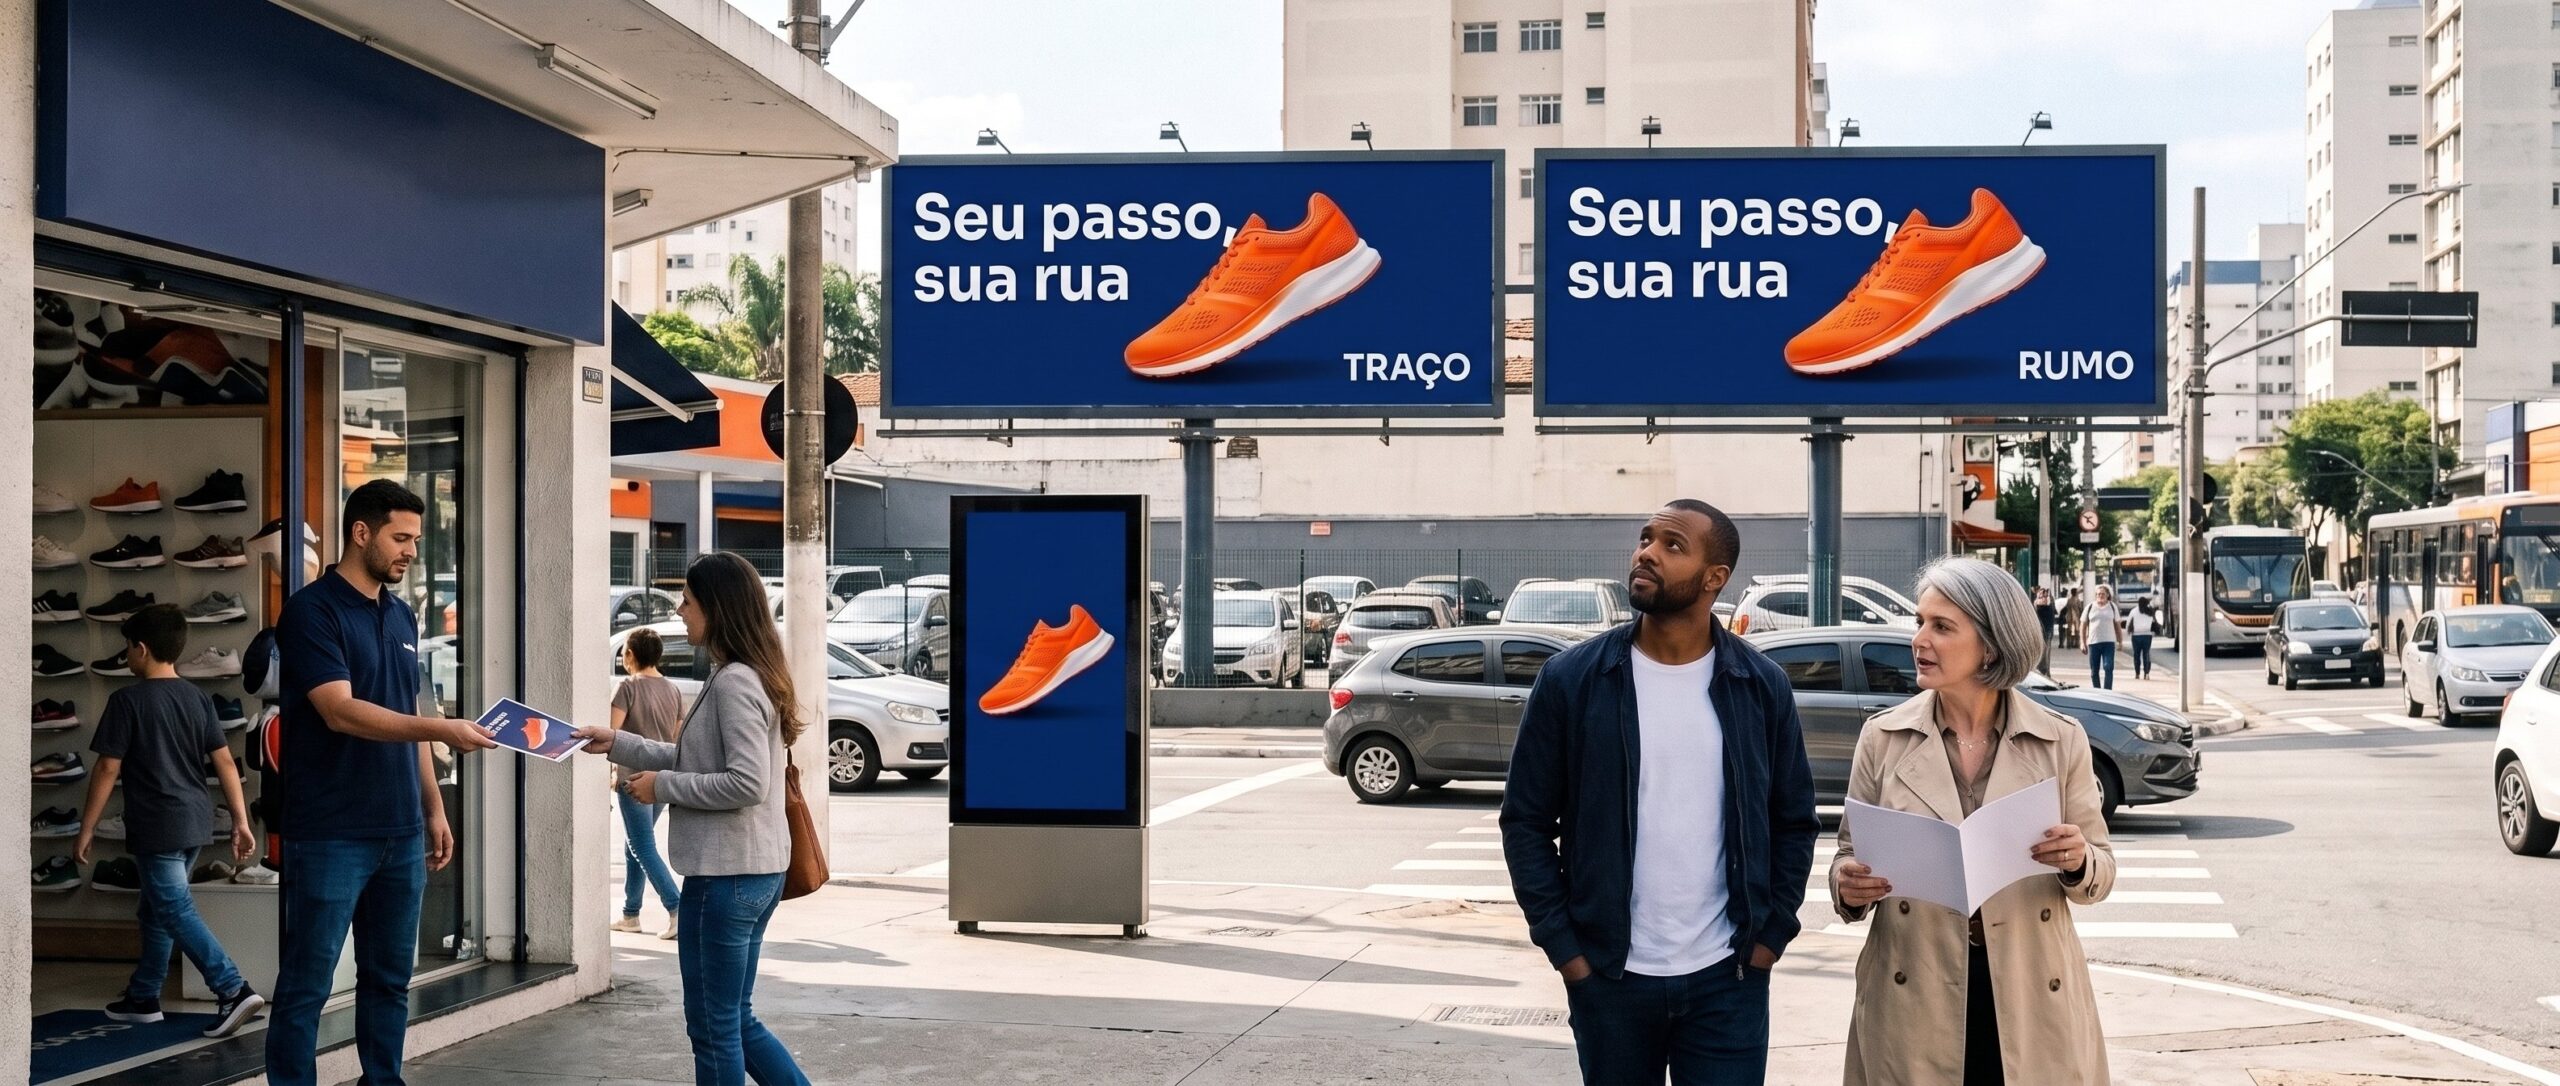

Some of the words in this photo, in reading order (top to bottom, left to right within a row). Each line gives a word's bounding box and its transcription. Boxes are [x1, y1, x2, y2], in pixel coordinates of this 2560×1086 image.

[913, 191, 1024, 241] Seu
[1043, 202, 1238, 253] passo,
[1567, 186, 1681, 237] Seu
[1700, 197, 1899, 249] passo,
[914, 265, 1017, 303] sua
[1035, 264, 1129, 302] rua
[1567, 261, 1673, 299] sua
[1692, 260, 1788, 299] rua
[1343, 352, 1471, 390] TRAÇO
[2018, 350, 2134, 381] RUMO
